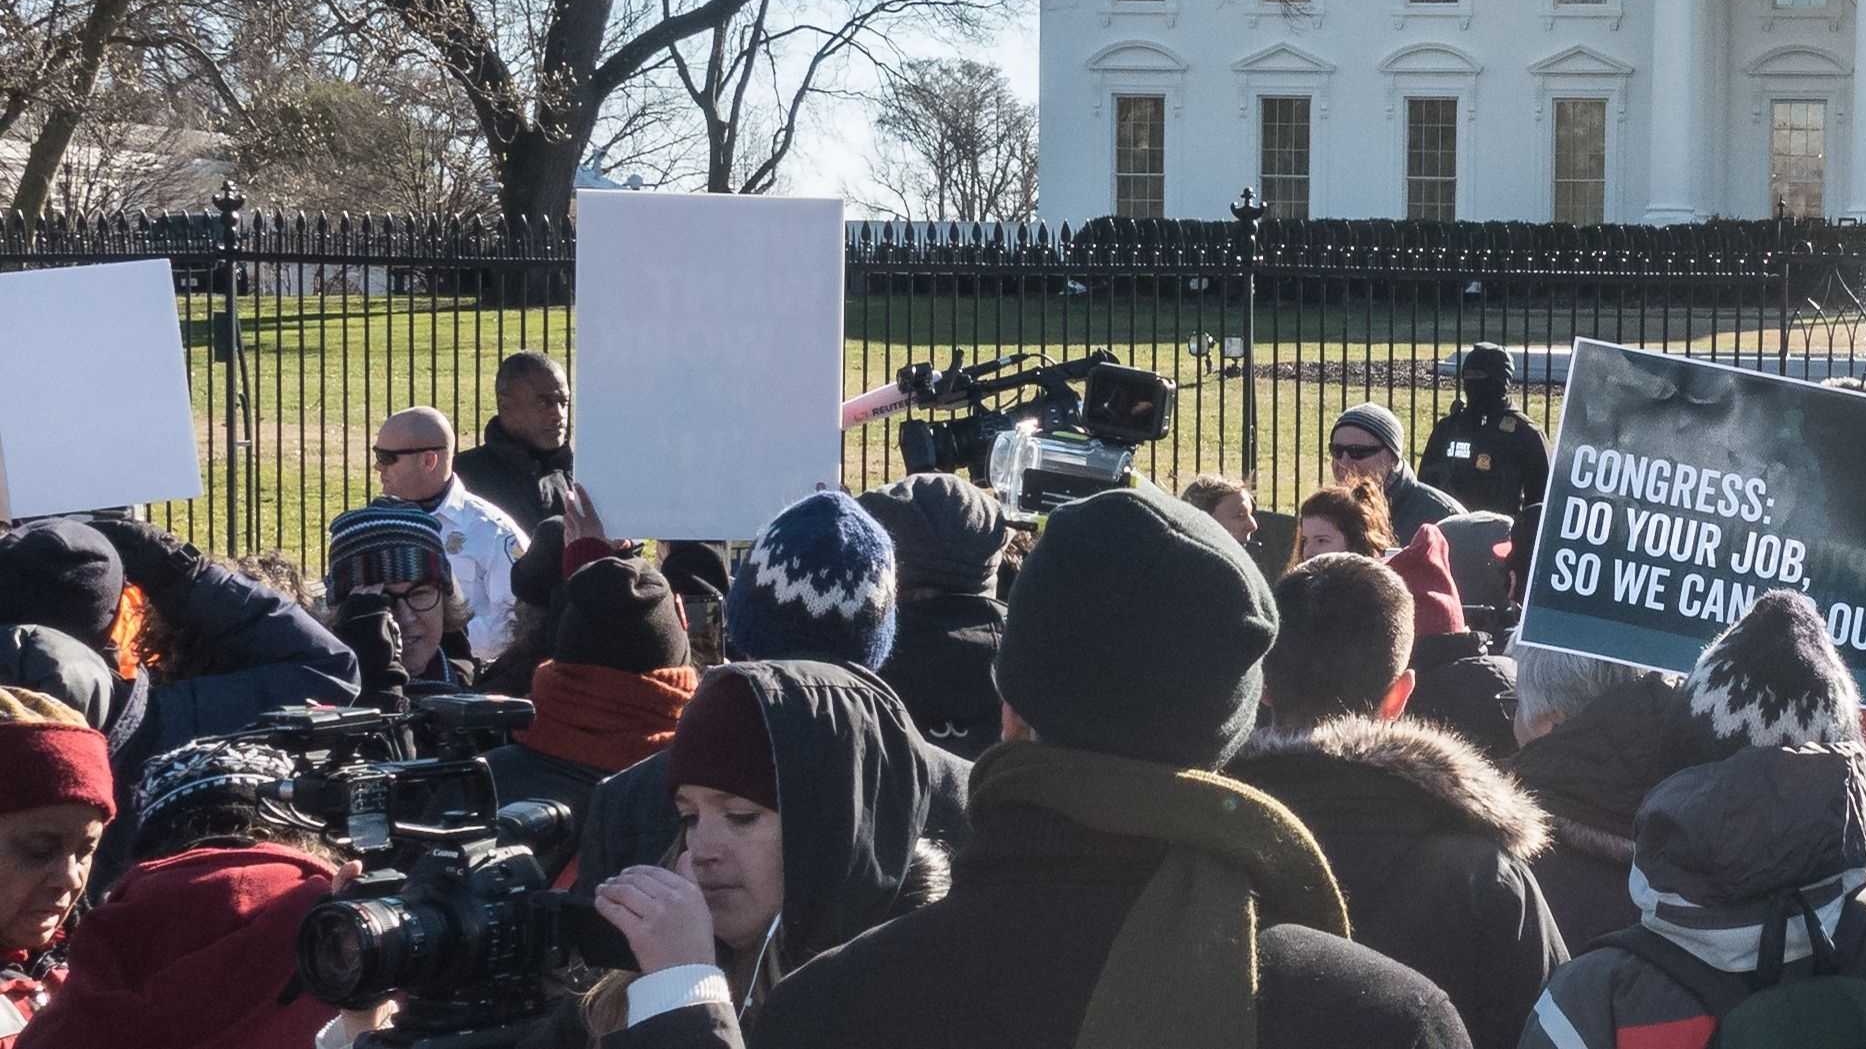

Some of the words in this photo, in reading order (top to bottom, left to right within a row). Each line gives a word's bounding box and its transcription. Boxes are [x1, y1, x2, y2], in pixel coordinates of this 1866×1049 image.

[1570, 444, 1775, 525] CONGRESS:
[1550, 547, 1601, 598] SO
[1614, 558, 1678, 612] WE
[1679, 573, 1755, 624] CAN
[1561, 496, 1613, 547] DO
[1626, 507, 1722, 569] YOUR
[1731, 530, 1811, 594] JOB,
